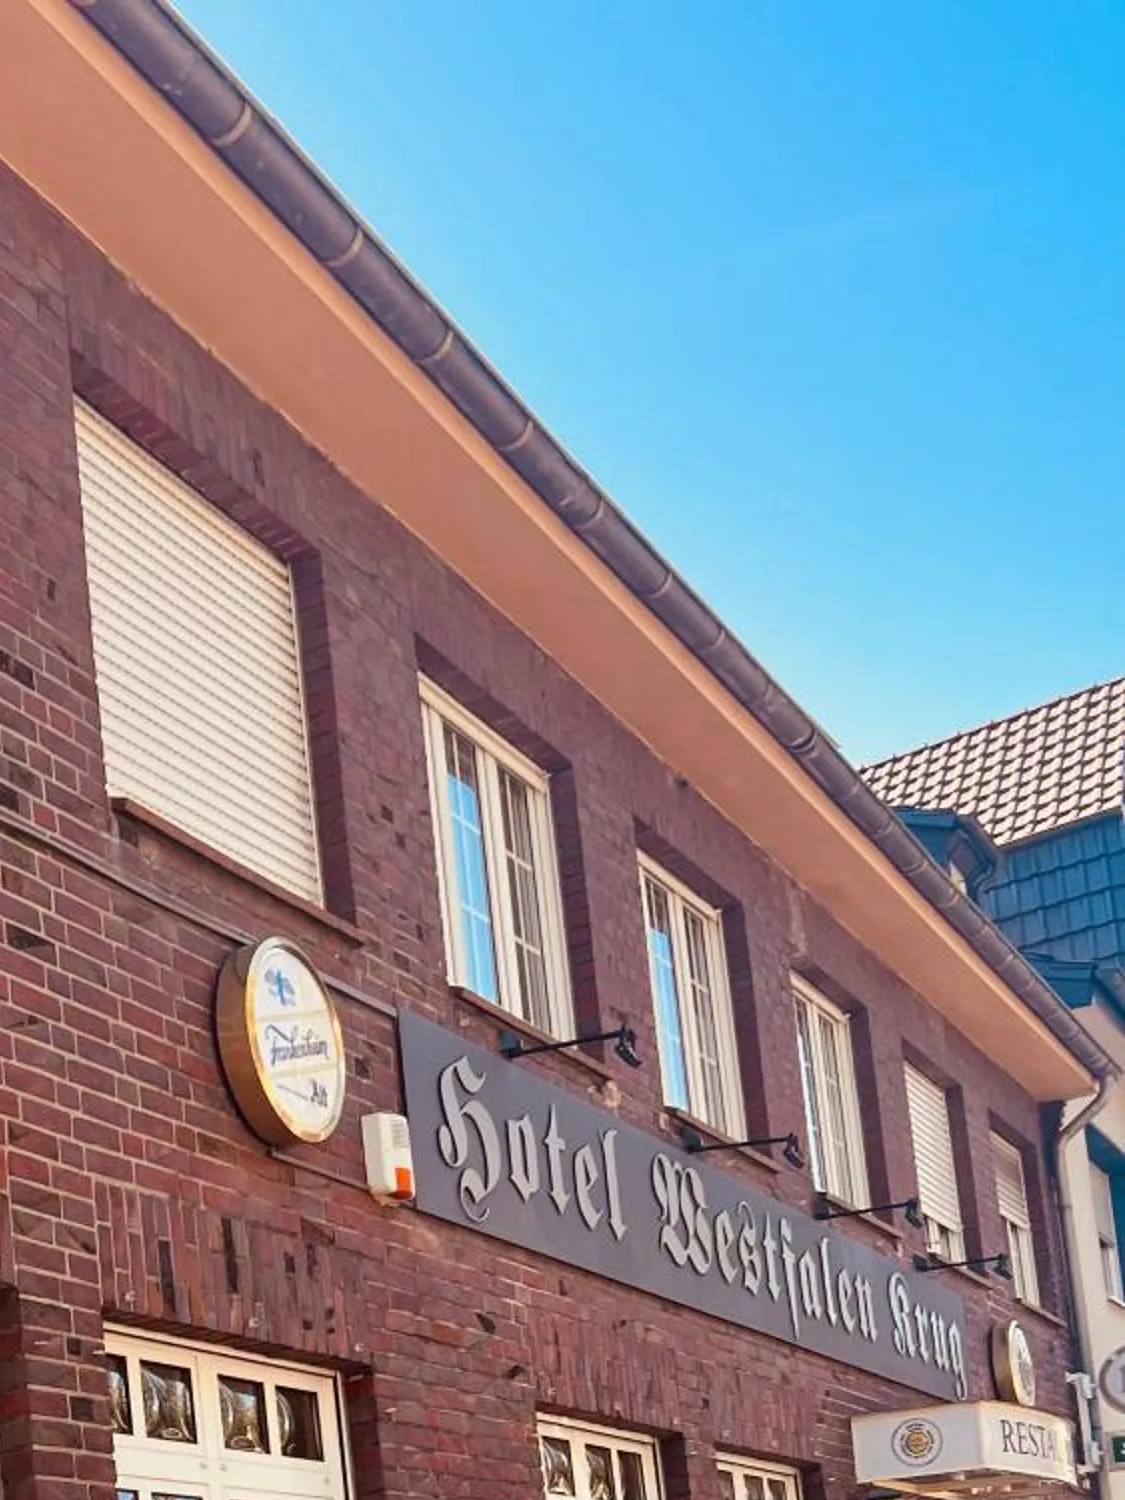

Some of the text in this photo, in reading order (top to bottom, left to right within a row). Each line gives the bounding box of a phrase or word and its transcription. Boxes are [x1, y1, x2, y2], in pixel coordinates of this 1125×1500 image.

[438, 1055, 968, 1401] Hotel Westfalen Krug
